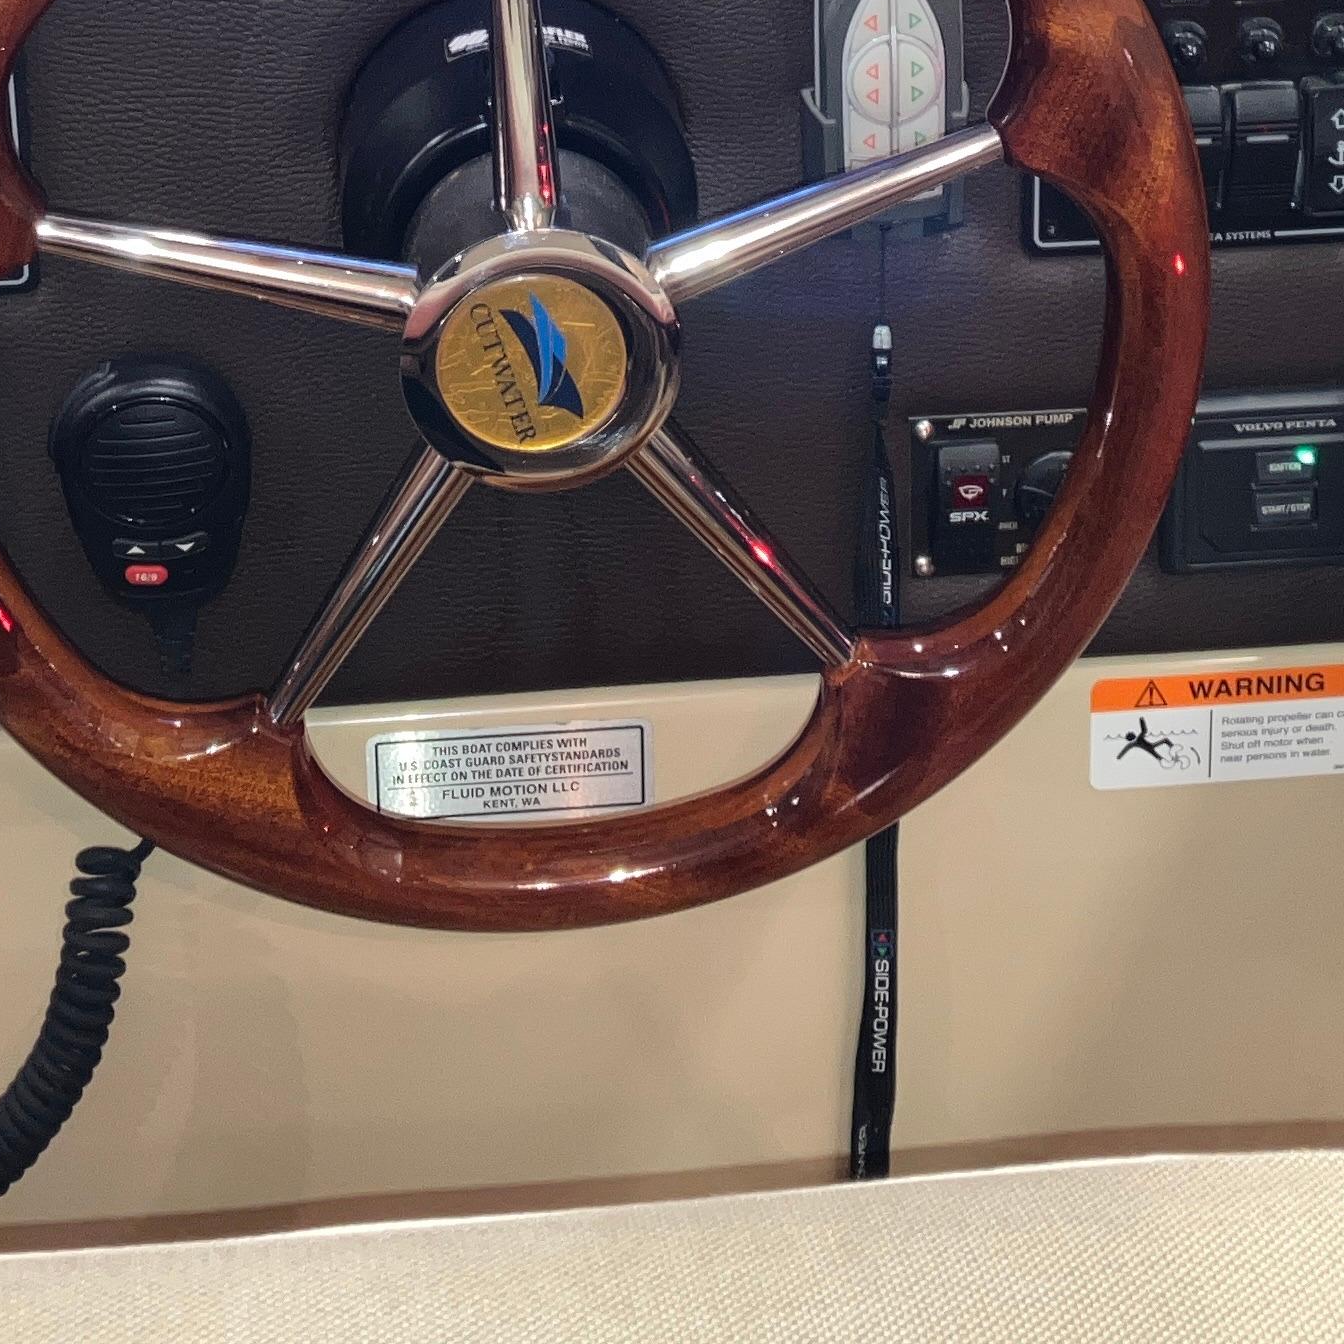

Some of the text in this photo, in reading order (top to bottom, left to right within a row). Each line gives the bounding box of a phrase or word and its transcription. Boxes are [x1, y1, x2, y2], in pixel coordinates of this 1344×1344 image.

[1208, 230, 1272, 242] EA SYSTEMS
[469, 302, 537, 445] CUTWATER
[969, 413, 1074, 429] JOHNSON PUMP
[1233, 418, 1337, 433] VOLVO PENTA
[949, 511, 990, 523] SPX
[1189, 672, 1325, 700] WARNING
[1221, 715, 1265, 726] Rotating
[1267, 711, 1312, 724] propeller
[1314, 709, 1335, 720] can
[1221, 727, 1259, 738] serious
[1261, 725, 1290, 737] injury
[1292, 726, 1303, 734] or
[432, 737, 587, 757] THIS BOAT COMPLIES WITH
[1220, 736, 1324, 751] Shut off motor when
[423, 758, 461, 770] COAST
[465, 755, 506, 767] GUARD
[1220, 754, 1243, 764] near
[1246, 752, 1287, 763] persons
[1290, 750, 1299, 758] in
[392, 759, 629, 786] IN EFFECT ON THE DATE OF CERTIFICATION
[442, 780, 580, 801] FLUID MOTION LLC
[521, 797, 542, 807] WA
[871, 958, 891, 1075] SIDE-POWER
